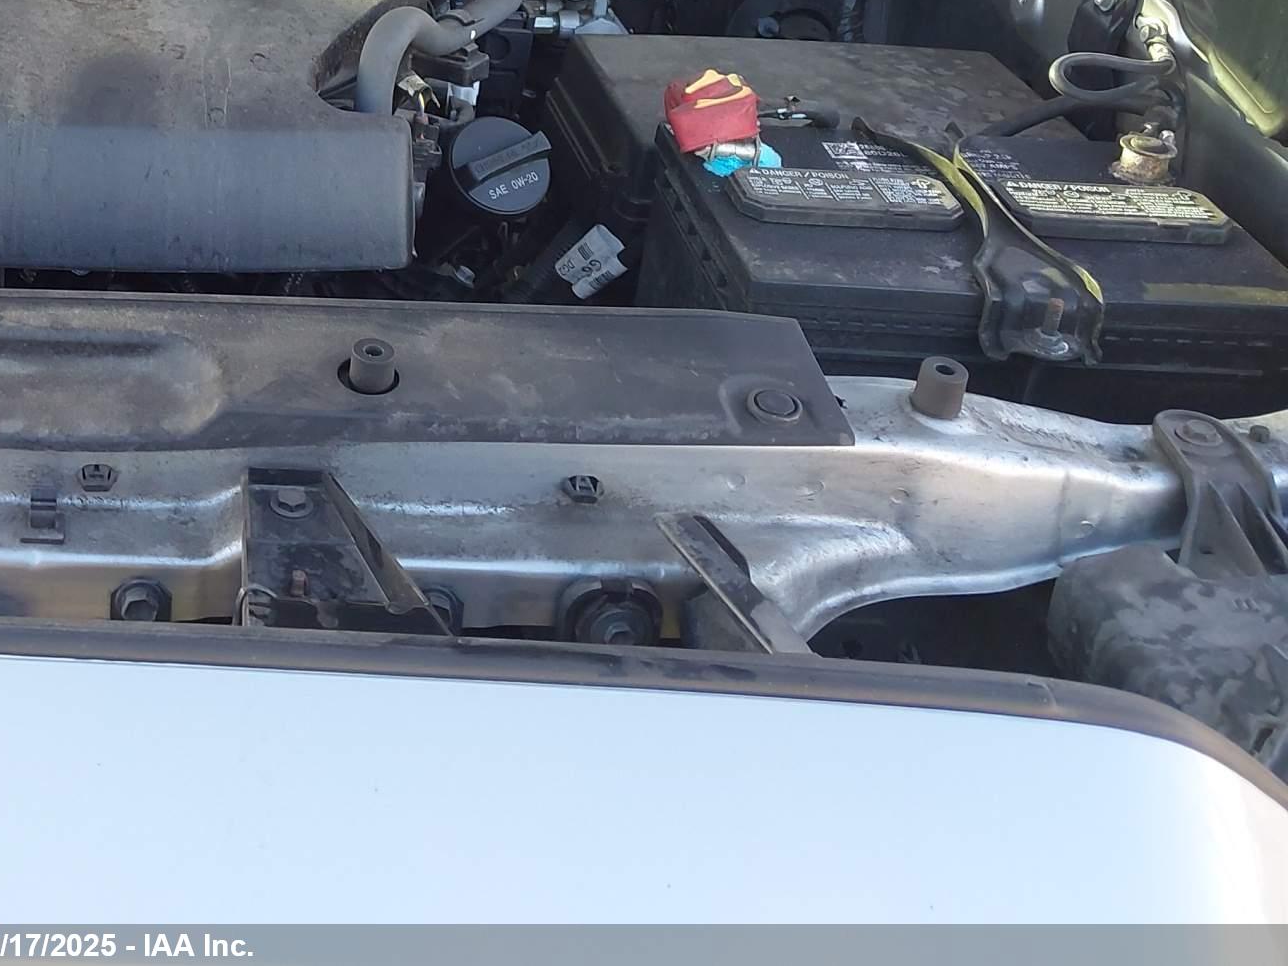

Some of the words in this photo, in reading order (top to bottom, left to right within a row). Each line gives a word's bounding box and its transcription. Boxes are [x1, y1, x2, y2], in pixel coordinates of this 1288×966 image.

[761, 168, 802, 178] DANGER
[811, 171, 850, 180] POISON
[487, 183, 510, 201] SAE
[510, 170, 540, 191] 0W-20
[1019, 181, 1062, 191] DANGER
[1069, 185, 1111, 194] POISON
